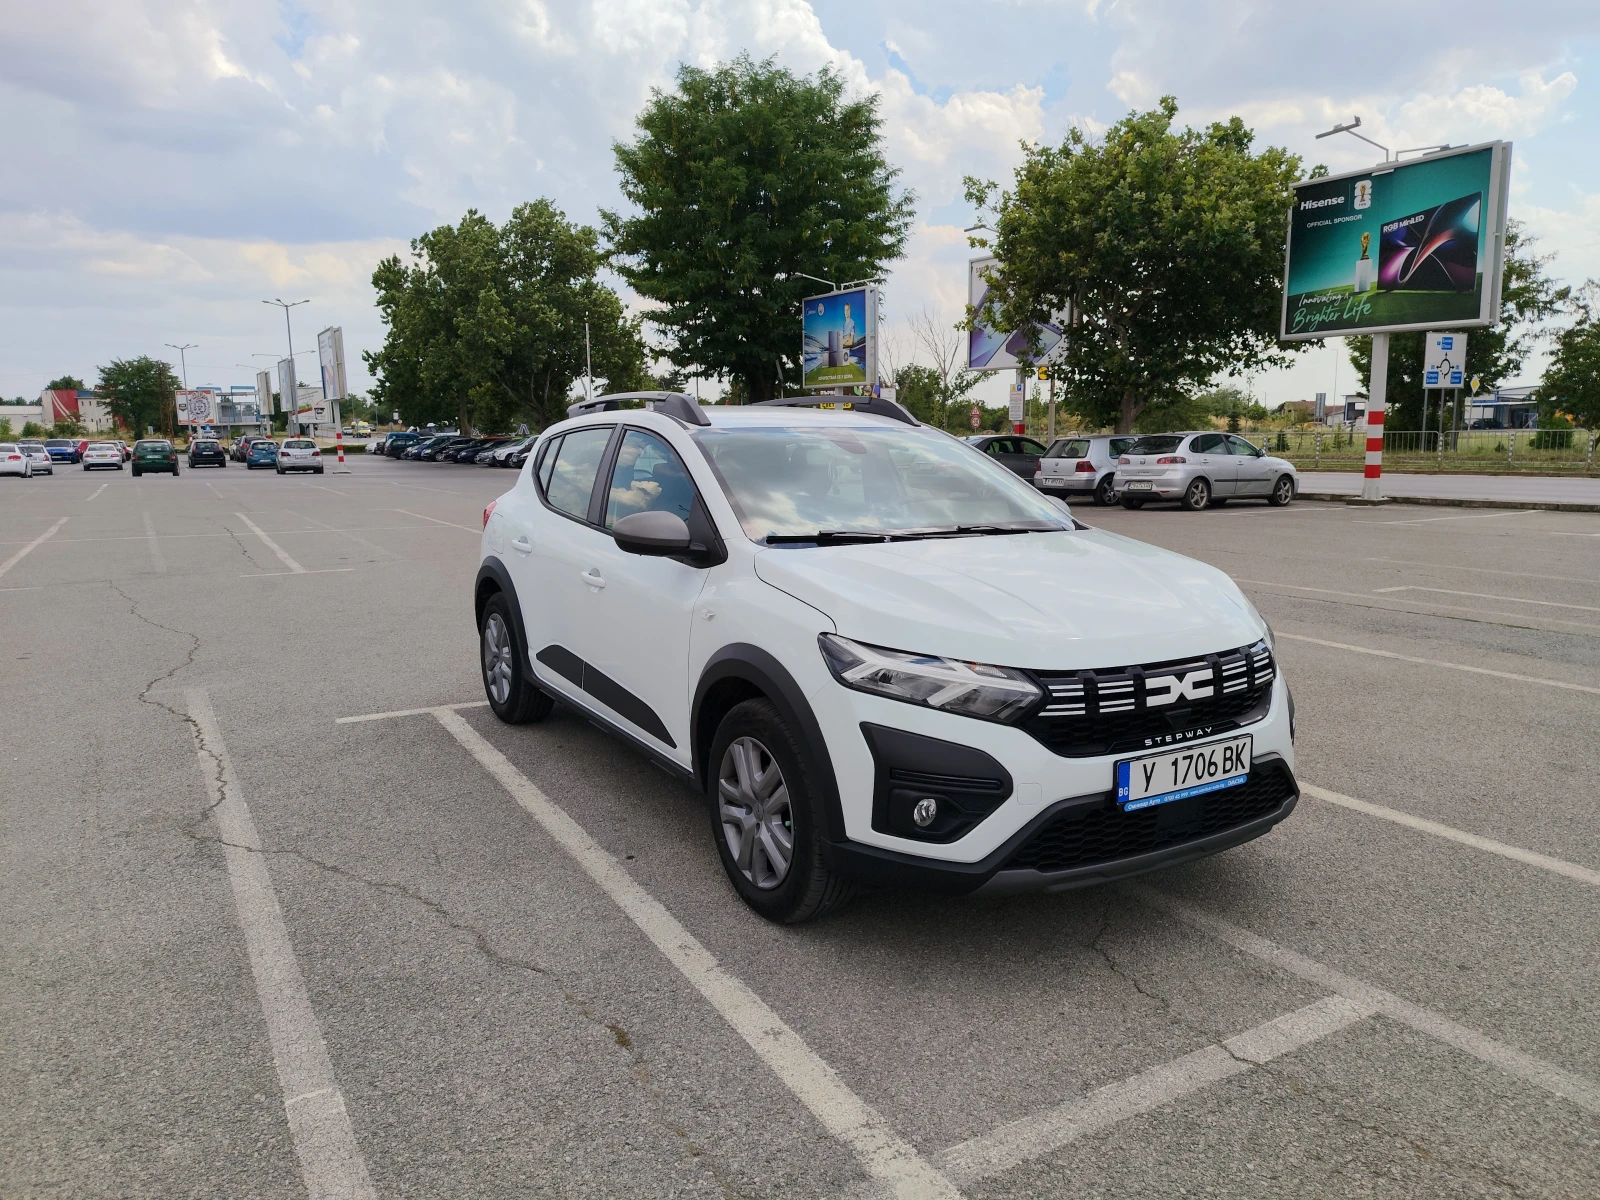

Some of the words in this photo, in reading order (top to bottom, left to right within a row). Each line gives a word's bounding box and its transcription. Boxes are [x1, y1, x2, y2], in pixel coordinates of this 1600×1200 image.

[1300, 195, 1345, 211] Hisense
[1306, 219, 1332, 228] OFFICIAL
[1333, 214, 1363, 224] SPONSOR
[1383, 222, 1398, 233] RGB
[1399, 214, 1425, 228] MiniLED
[1298, 290, 1342, 307] Innovating
[1290, 305, 1341, 333] Brighter
[1342, 295, 1372, 322] Life
[1144, 726, 1213, 746] STEPWAY
[1171, 749, 1218, 786] 1706
[1222, 742, 1247, 775] BK
[1228, 778, 1244, 786] DACIA
[1118, 787, 1129, 797] BG
